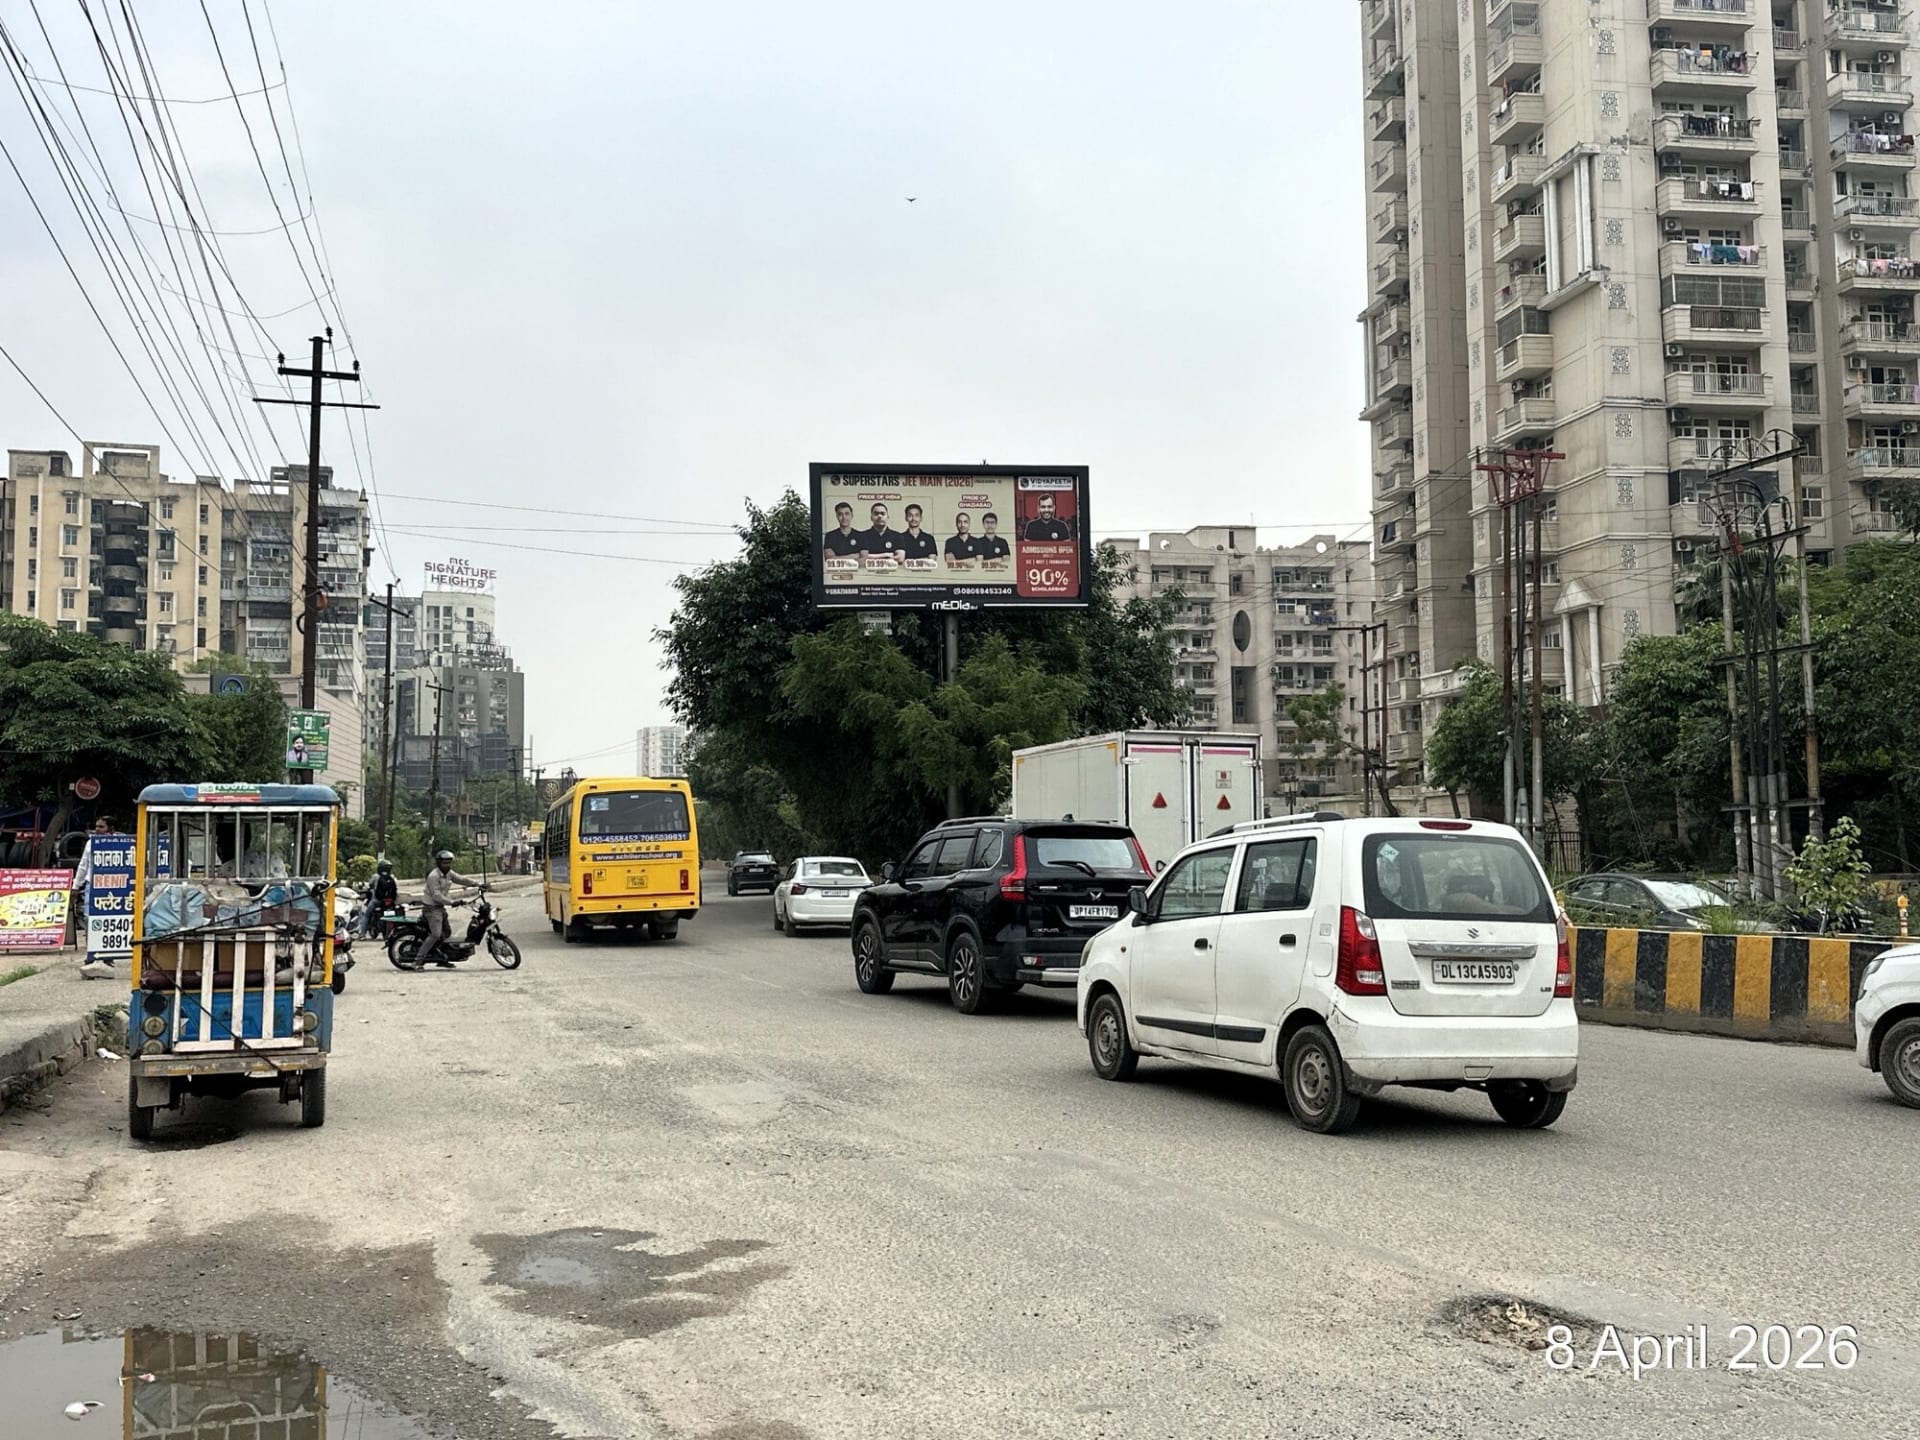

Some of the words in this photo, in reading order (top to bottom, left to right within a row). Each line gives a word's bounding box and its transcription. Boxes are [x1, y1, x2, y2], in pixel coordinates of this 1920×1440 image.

[842, 476, 900, 486] SUPERSTARS
[902, 476, 918, 487] JEE
[919, 476, 943, 487] MAIN
[945, 476, 974, 488] (2026)
[424, 562, 496, 579] SIGNATURE
[1029, 569, 1068, 586] 90%
[431, 574, 484, 588] HEIGHTS
[94, 850, 123, 867] कालका
[93, 874, 129, 888] RENT
[1442, 964, 1512, 979] DL13CA5903
